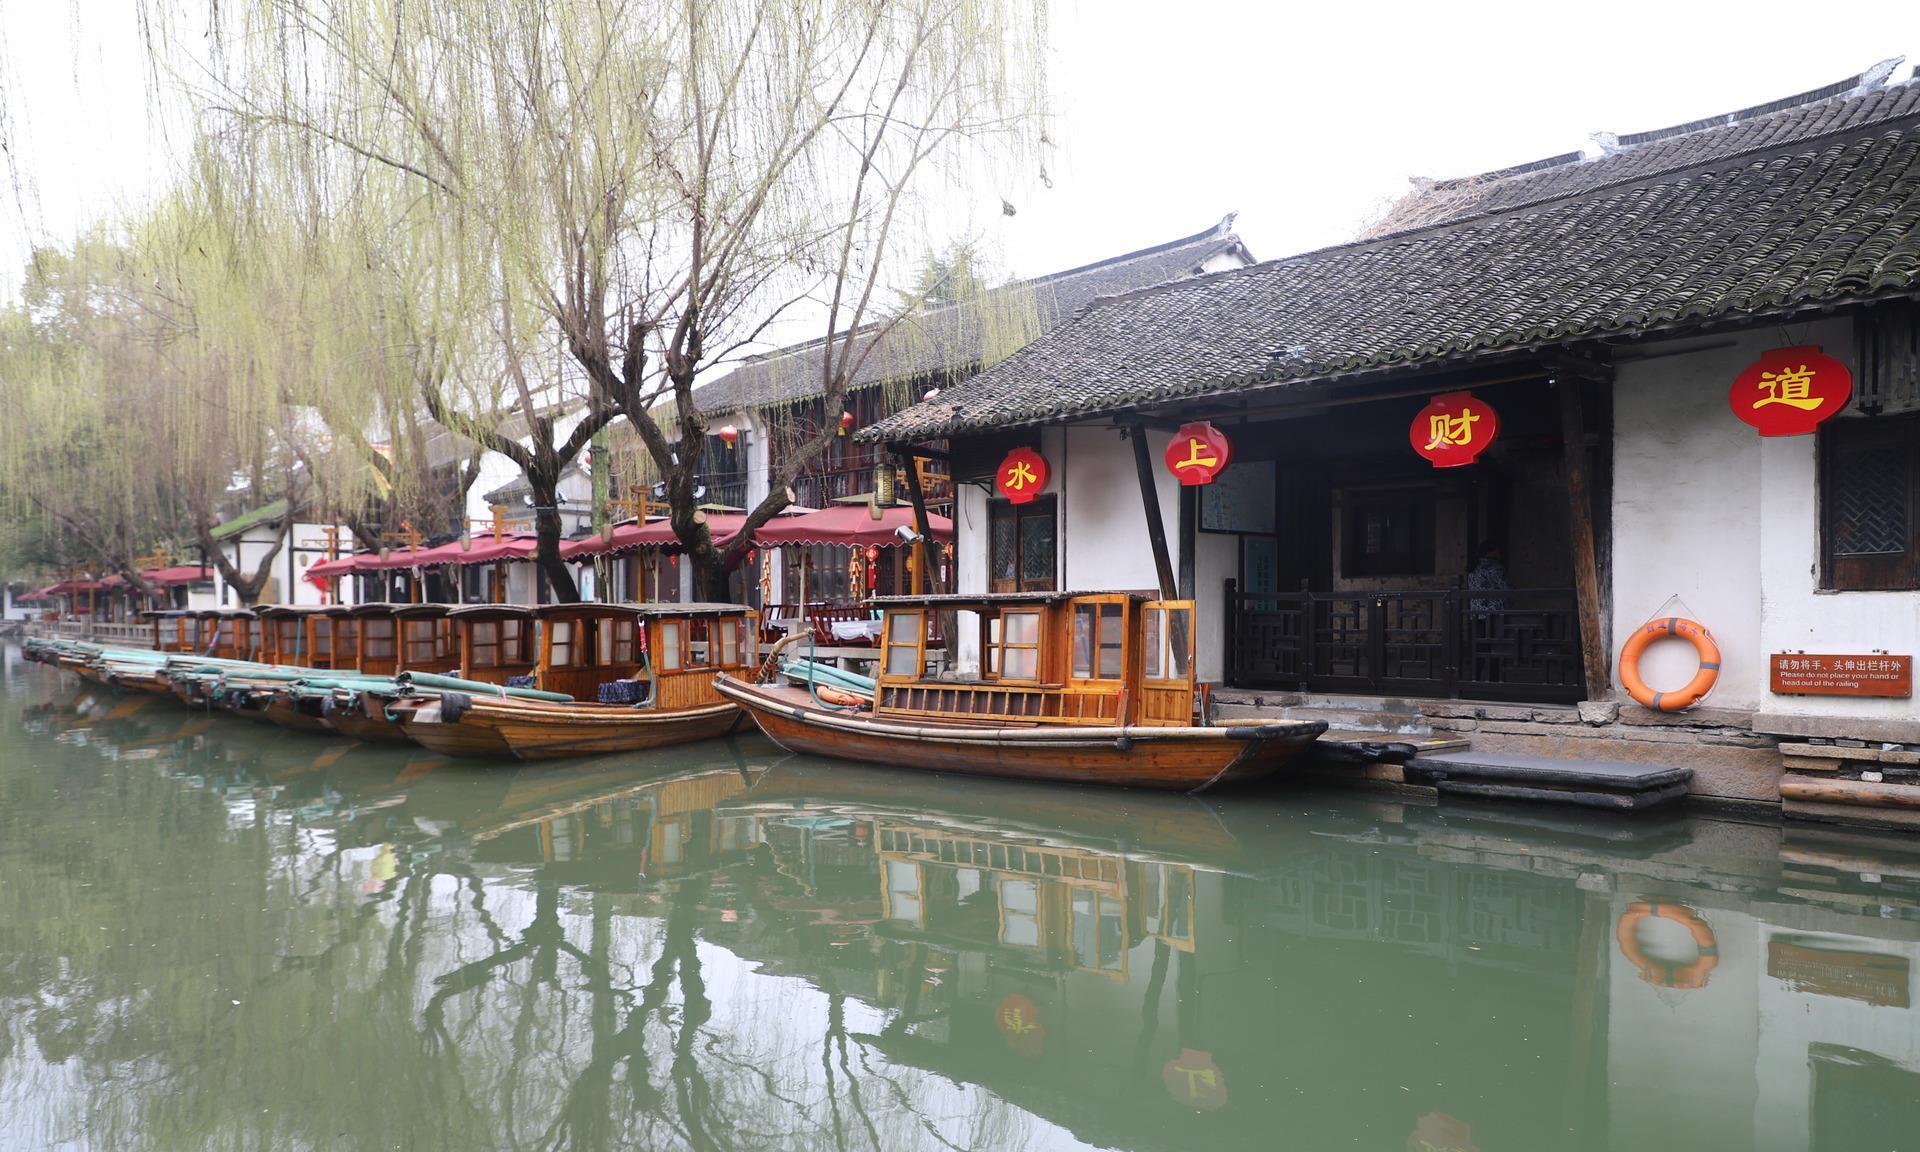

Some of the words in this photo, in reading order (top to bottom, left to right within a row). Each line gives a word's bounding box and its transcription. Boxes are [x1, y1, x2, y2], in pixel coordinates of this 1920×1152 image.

[1753, 364, 1824, 411] 道
[1424, 408, 1480, 450] 财
[1175, 438, 1217, 469] 上
[1005, 461, 1037, 490] 水
[1779, 659, 1902, 671] 请勿将手、头伸出栏杆外
[1829, 672, 1850, 680] place
